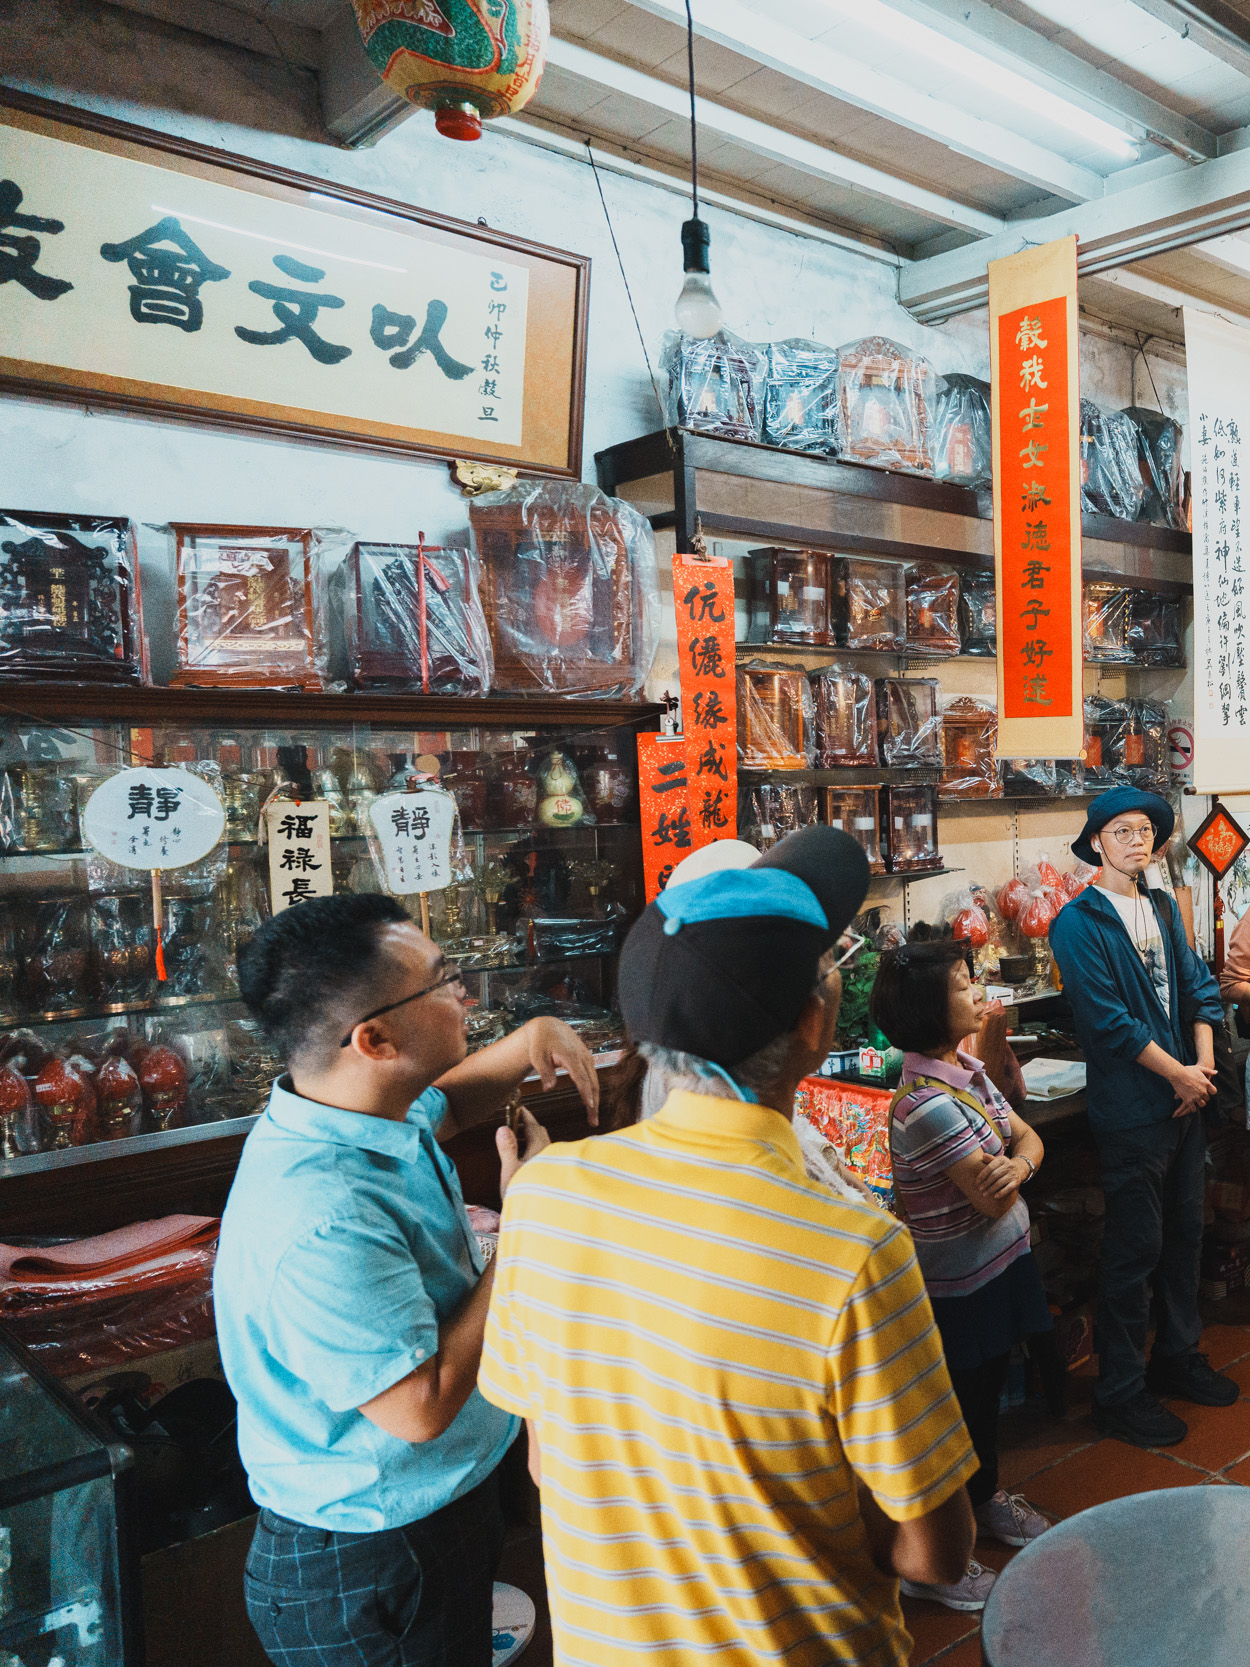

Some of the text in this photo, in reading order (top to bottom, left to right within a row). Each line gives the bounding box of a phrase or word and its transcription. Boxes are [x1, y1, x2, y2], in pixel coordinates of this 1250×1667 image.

[127, 783, 184, 821] 靜
[555, 799, 572, 815] 佛
[391, 806, 431, 841] 靜
